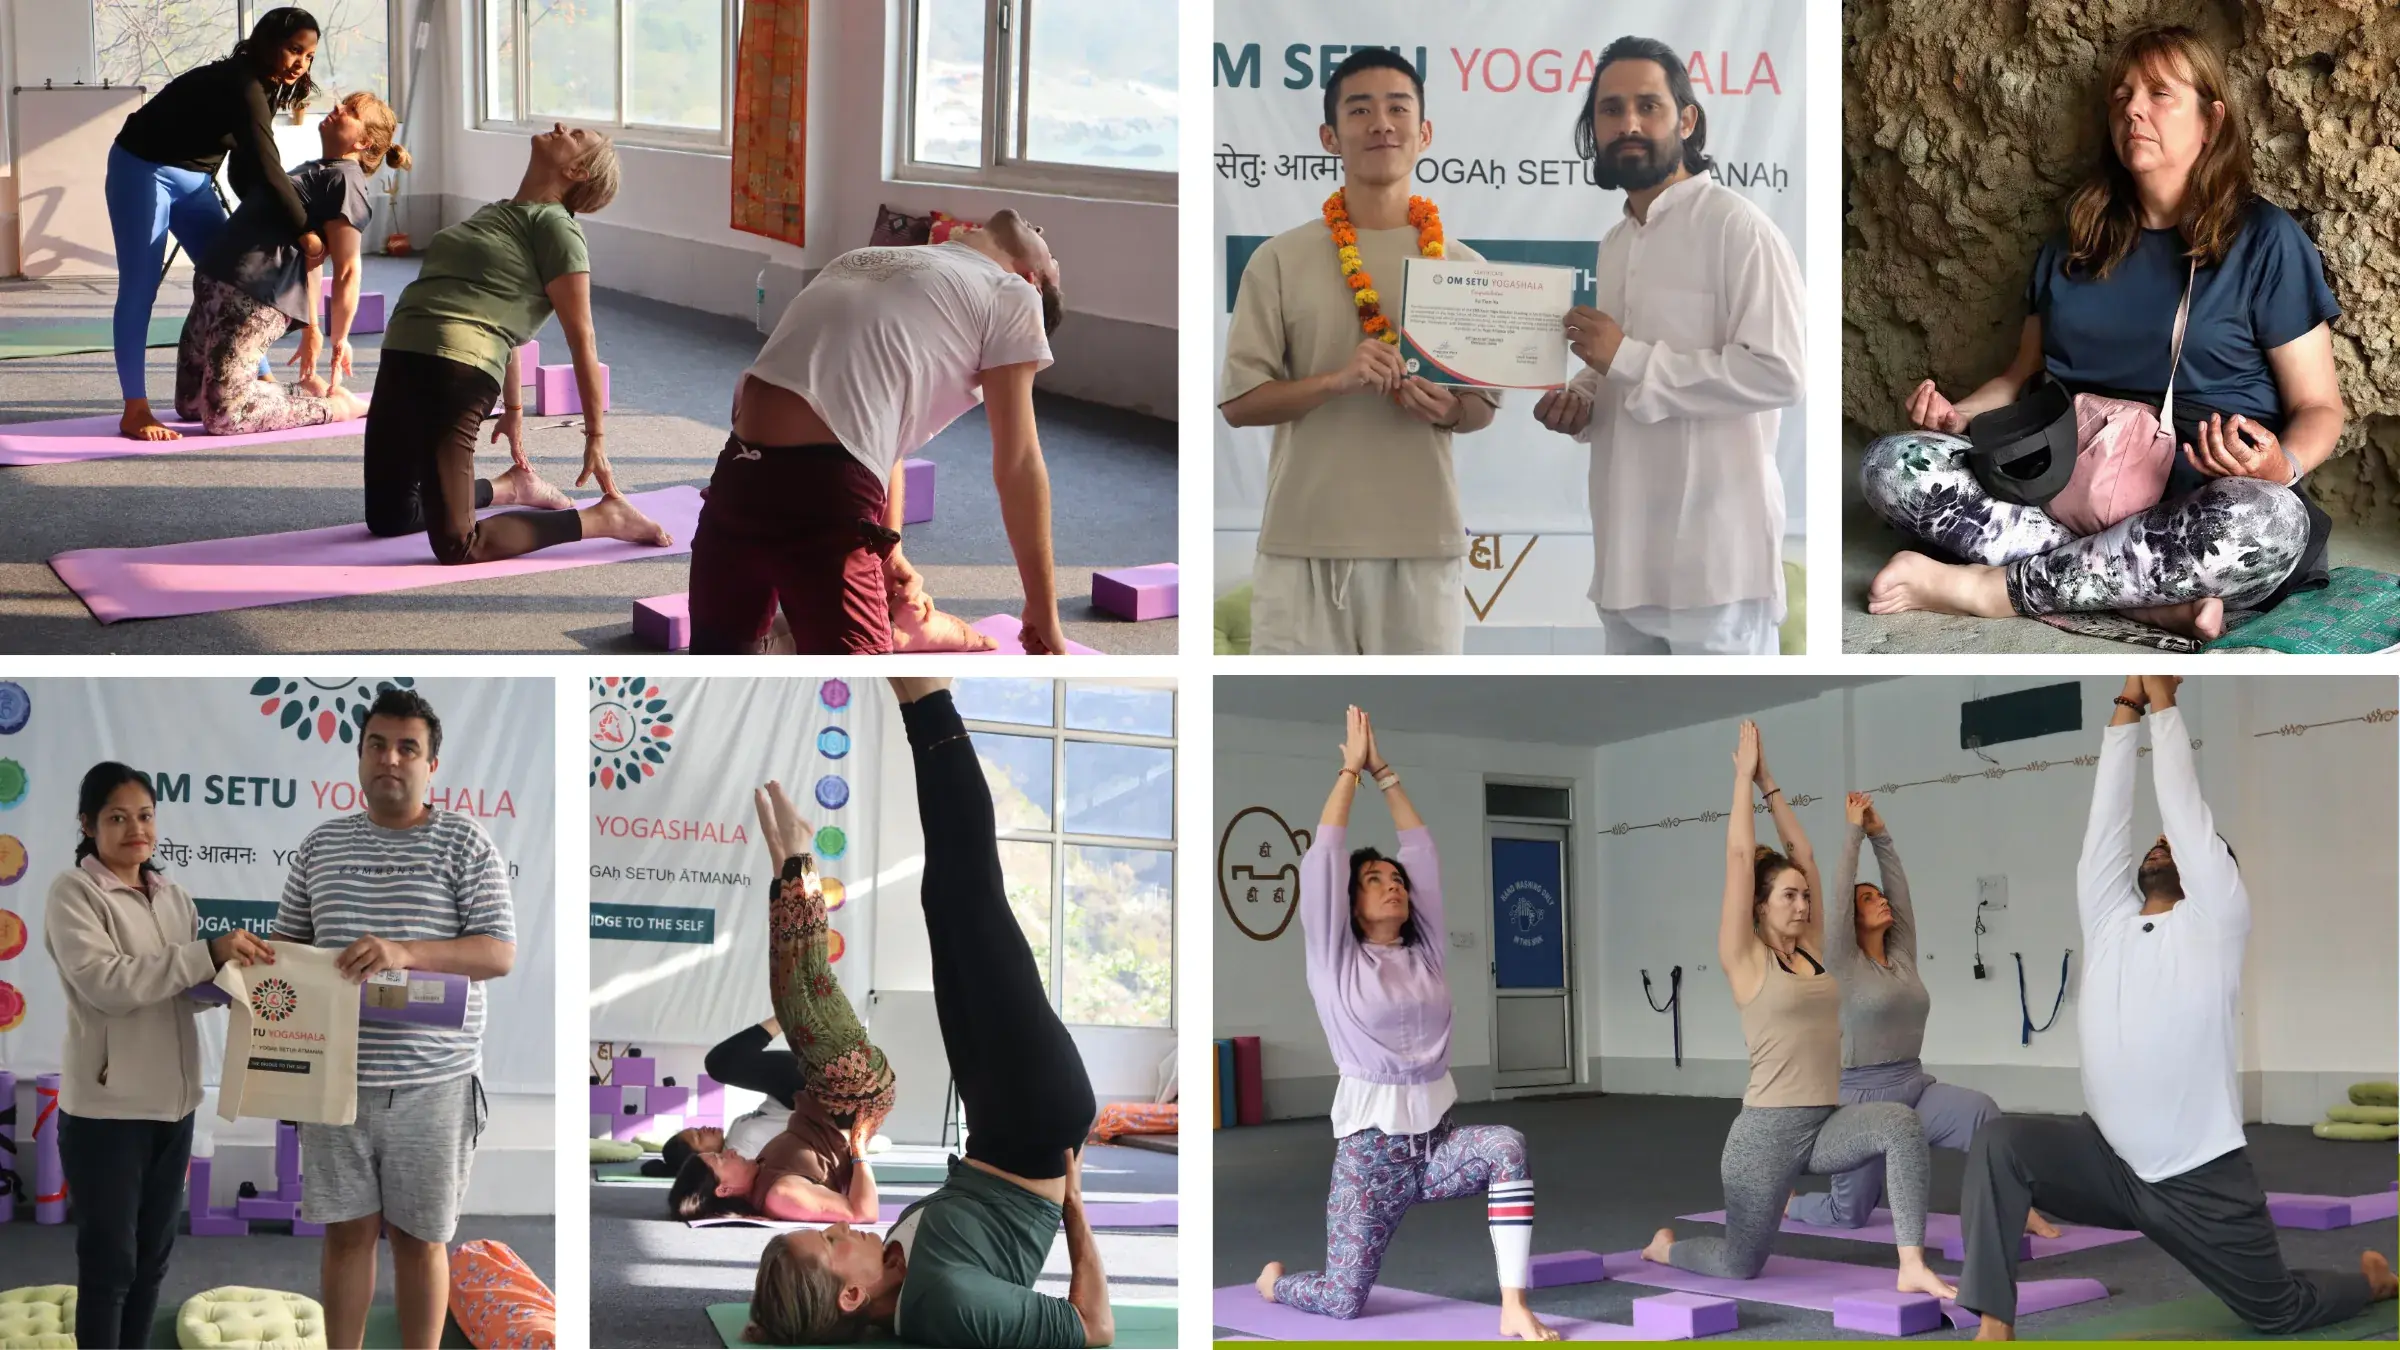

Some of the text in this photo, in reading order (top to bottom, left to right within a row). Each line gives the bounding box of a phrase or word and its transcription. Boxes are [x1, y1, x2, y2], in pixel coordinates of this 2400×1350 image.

[1283, 43, 1427, 90] SEU
[1450, 47, 1782, 96] YOGAALA
[1517, 159, 1597, 187] SETU
[1446, 276, 1544, 291] OM SETU YOGASHALA
[1572, 268, 1598, 291] TH
[204, 774, 297, 809] SETU
[311, 780, 516, 818] YOHALA
[595, 815, 749, 845] YOGASHALA
[1500, 880, 1555, 906] HAND WASHING ONLY
[625, 916, 644, 929] TO
[647, 917, 672, 930] THE
[675, 919, 705, 931] SELF
[268, 1029, 326, 1042] YOGASHALA
